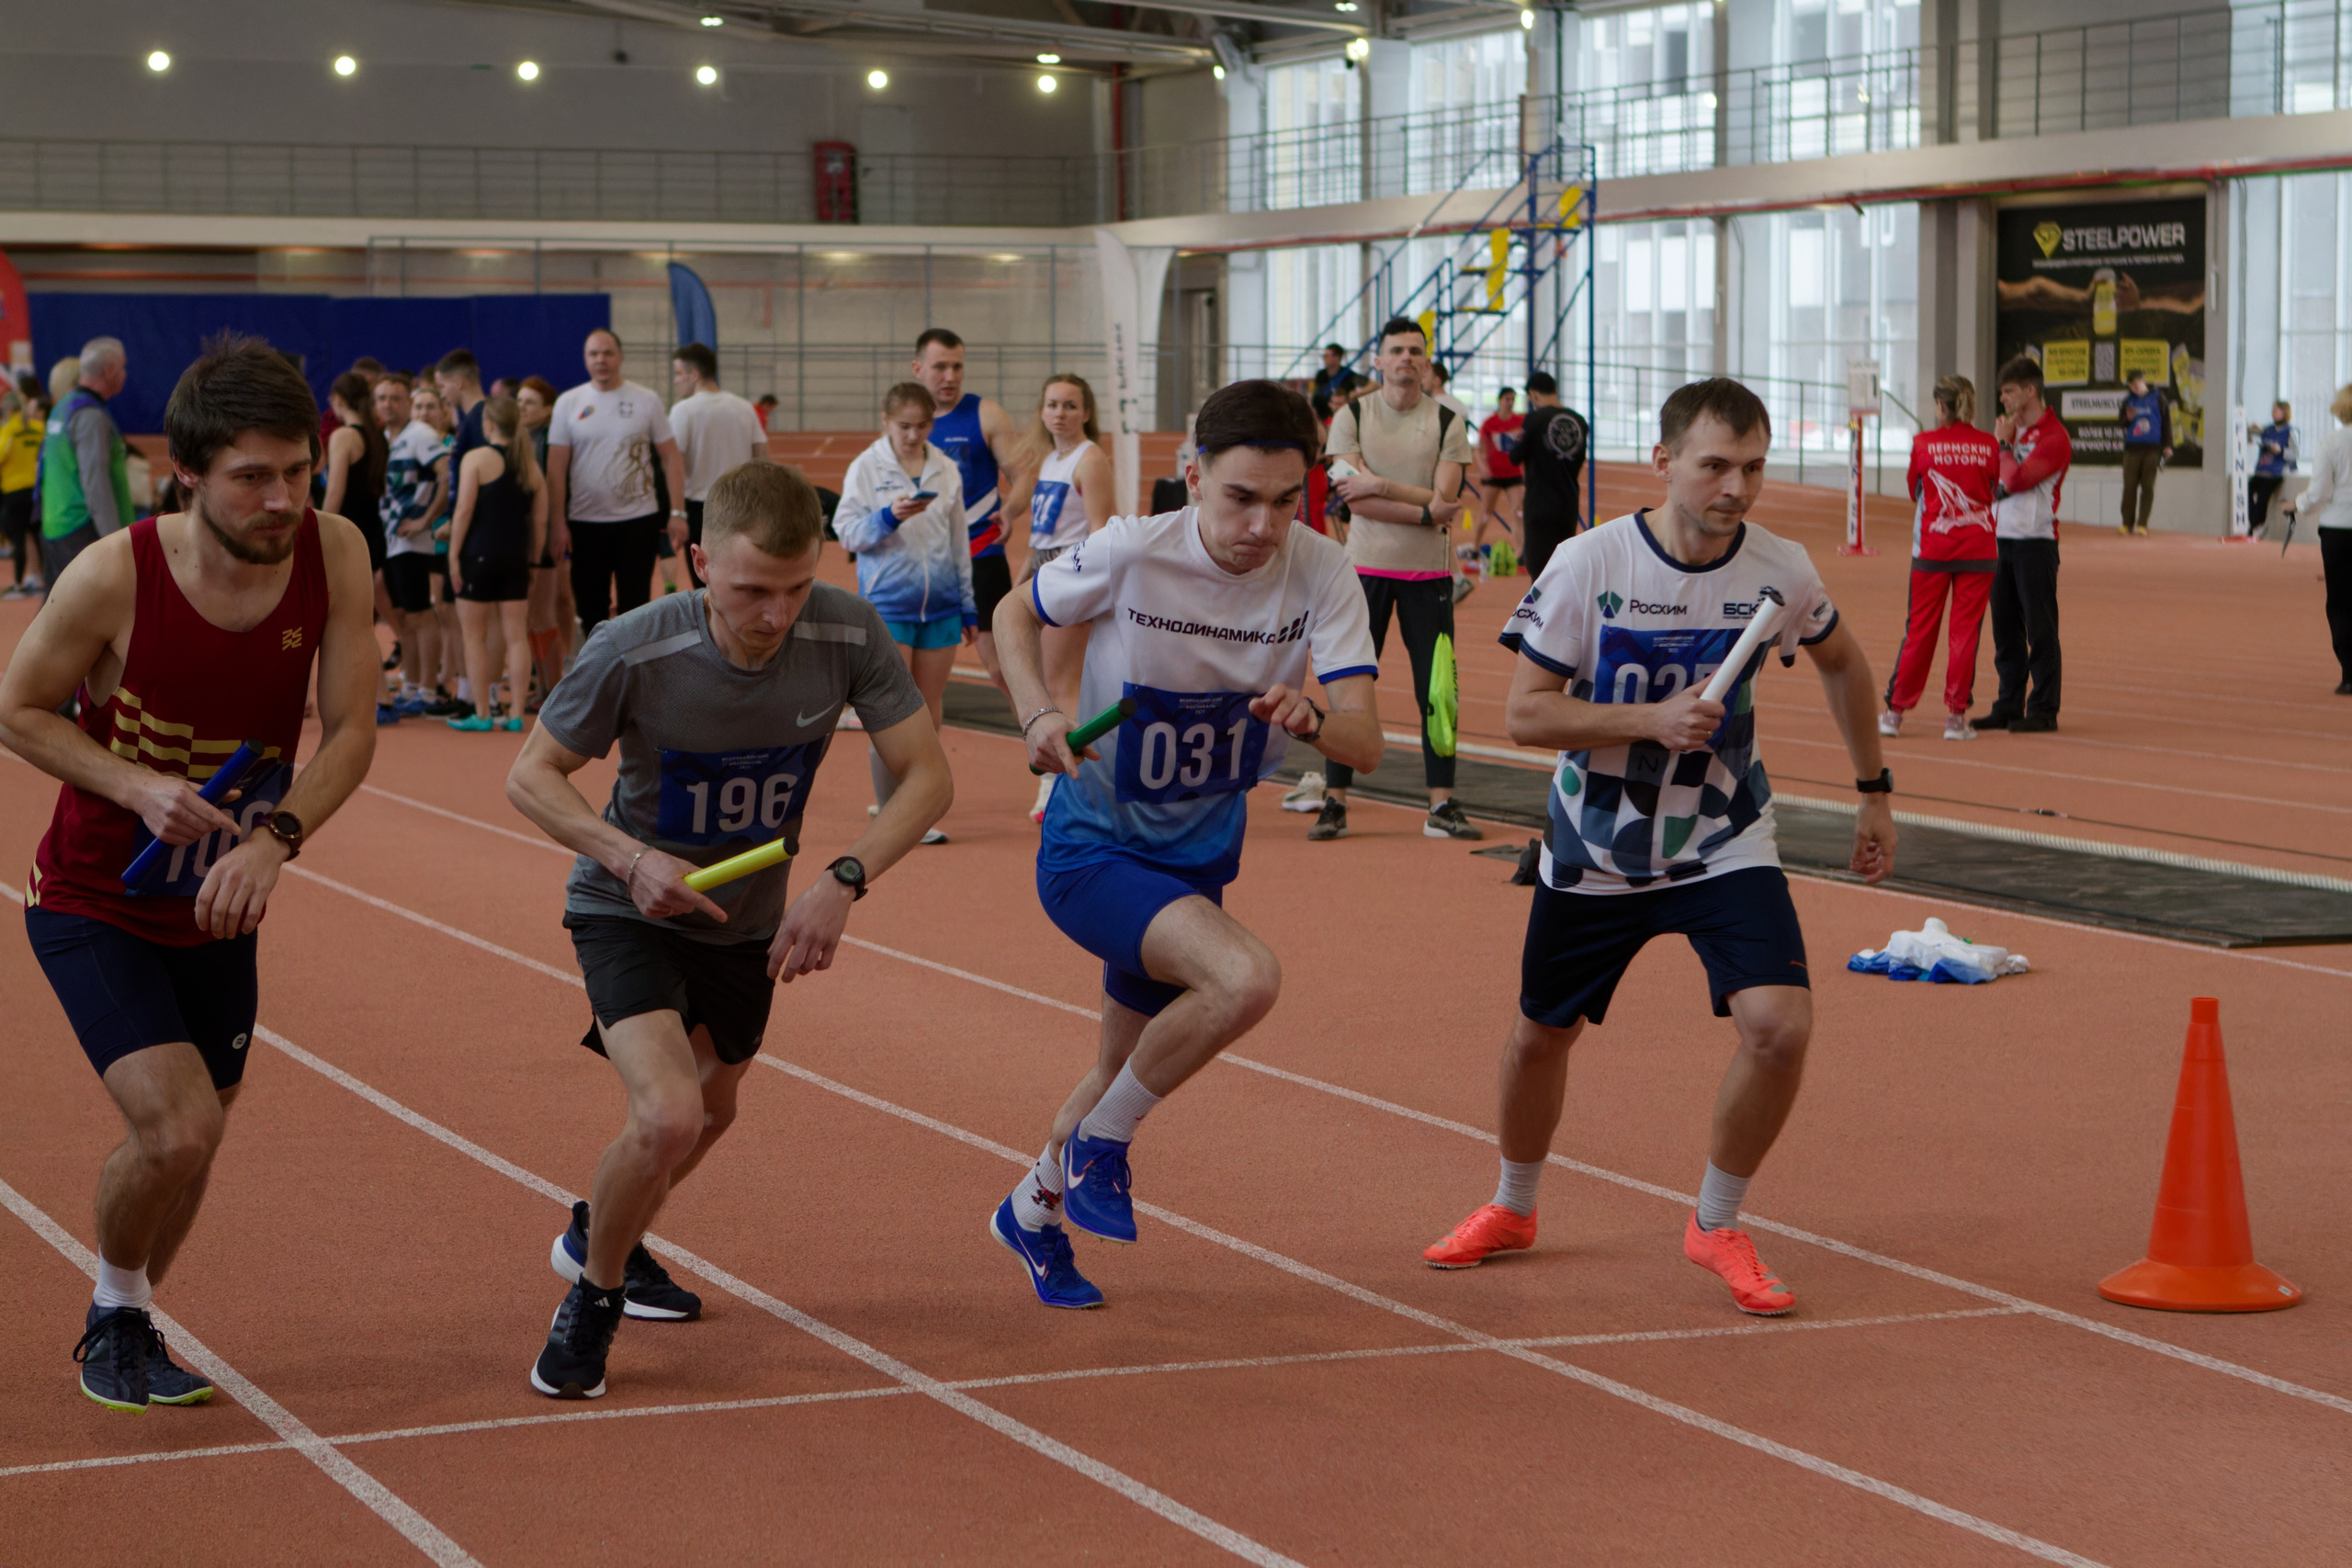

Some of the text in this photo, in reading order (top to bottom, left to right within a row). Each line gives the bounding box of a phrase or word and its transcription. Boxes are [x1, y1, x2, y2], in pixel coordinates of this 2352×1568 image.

[2062, 222, 2185, 251] STEELPOWER
[1928, 442, 1991, 457] ПЕРМСКИЕ
[1934, 454, 1986, 467] МОТОРЫ
[2234, 423, 2245, 525] FINISH
[1723, 603, 1759, 615] БСК
[1127, 607, 1276, 645] ТЕХНОДИНАМИКА
[1139, 717, 1249, 790] 031
[686, 773, 798, 834] 196
